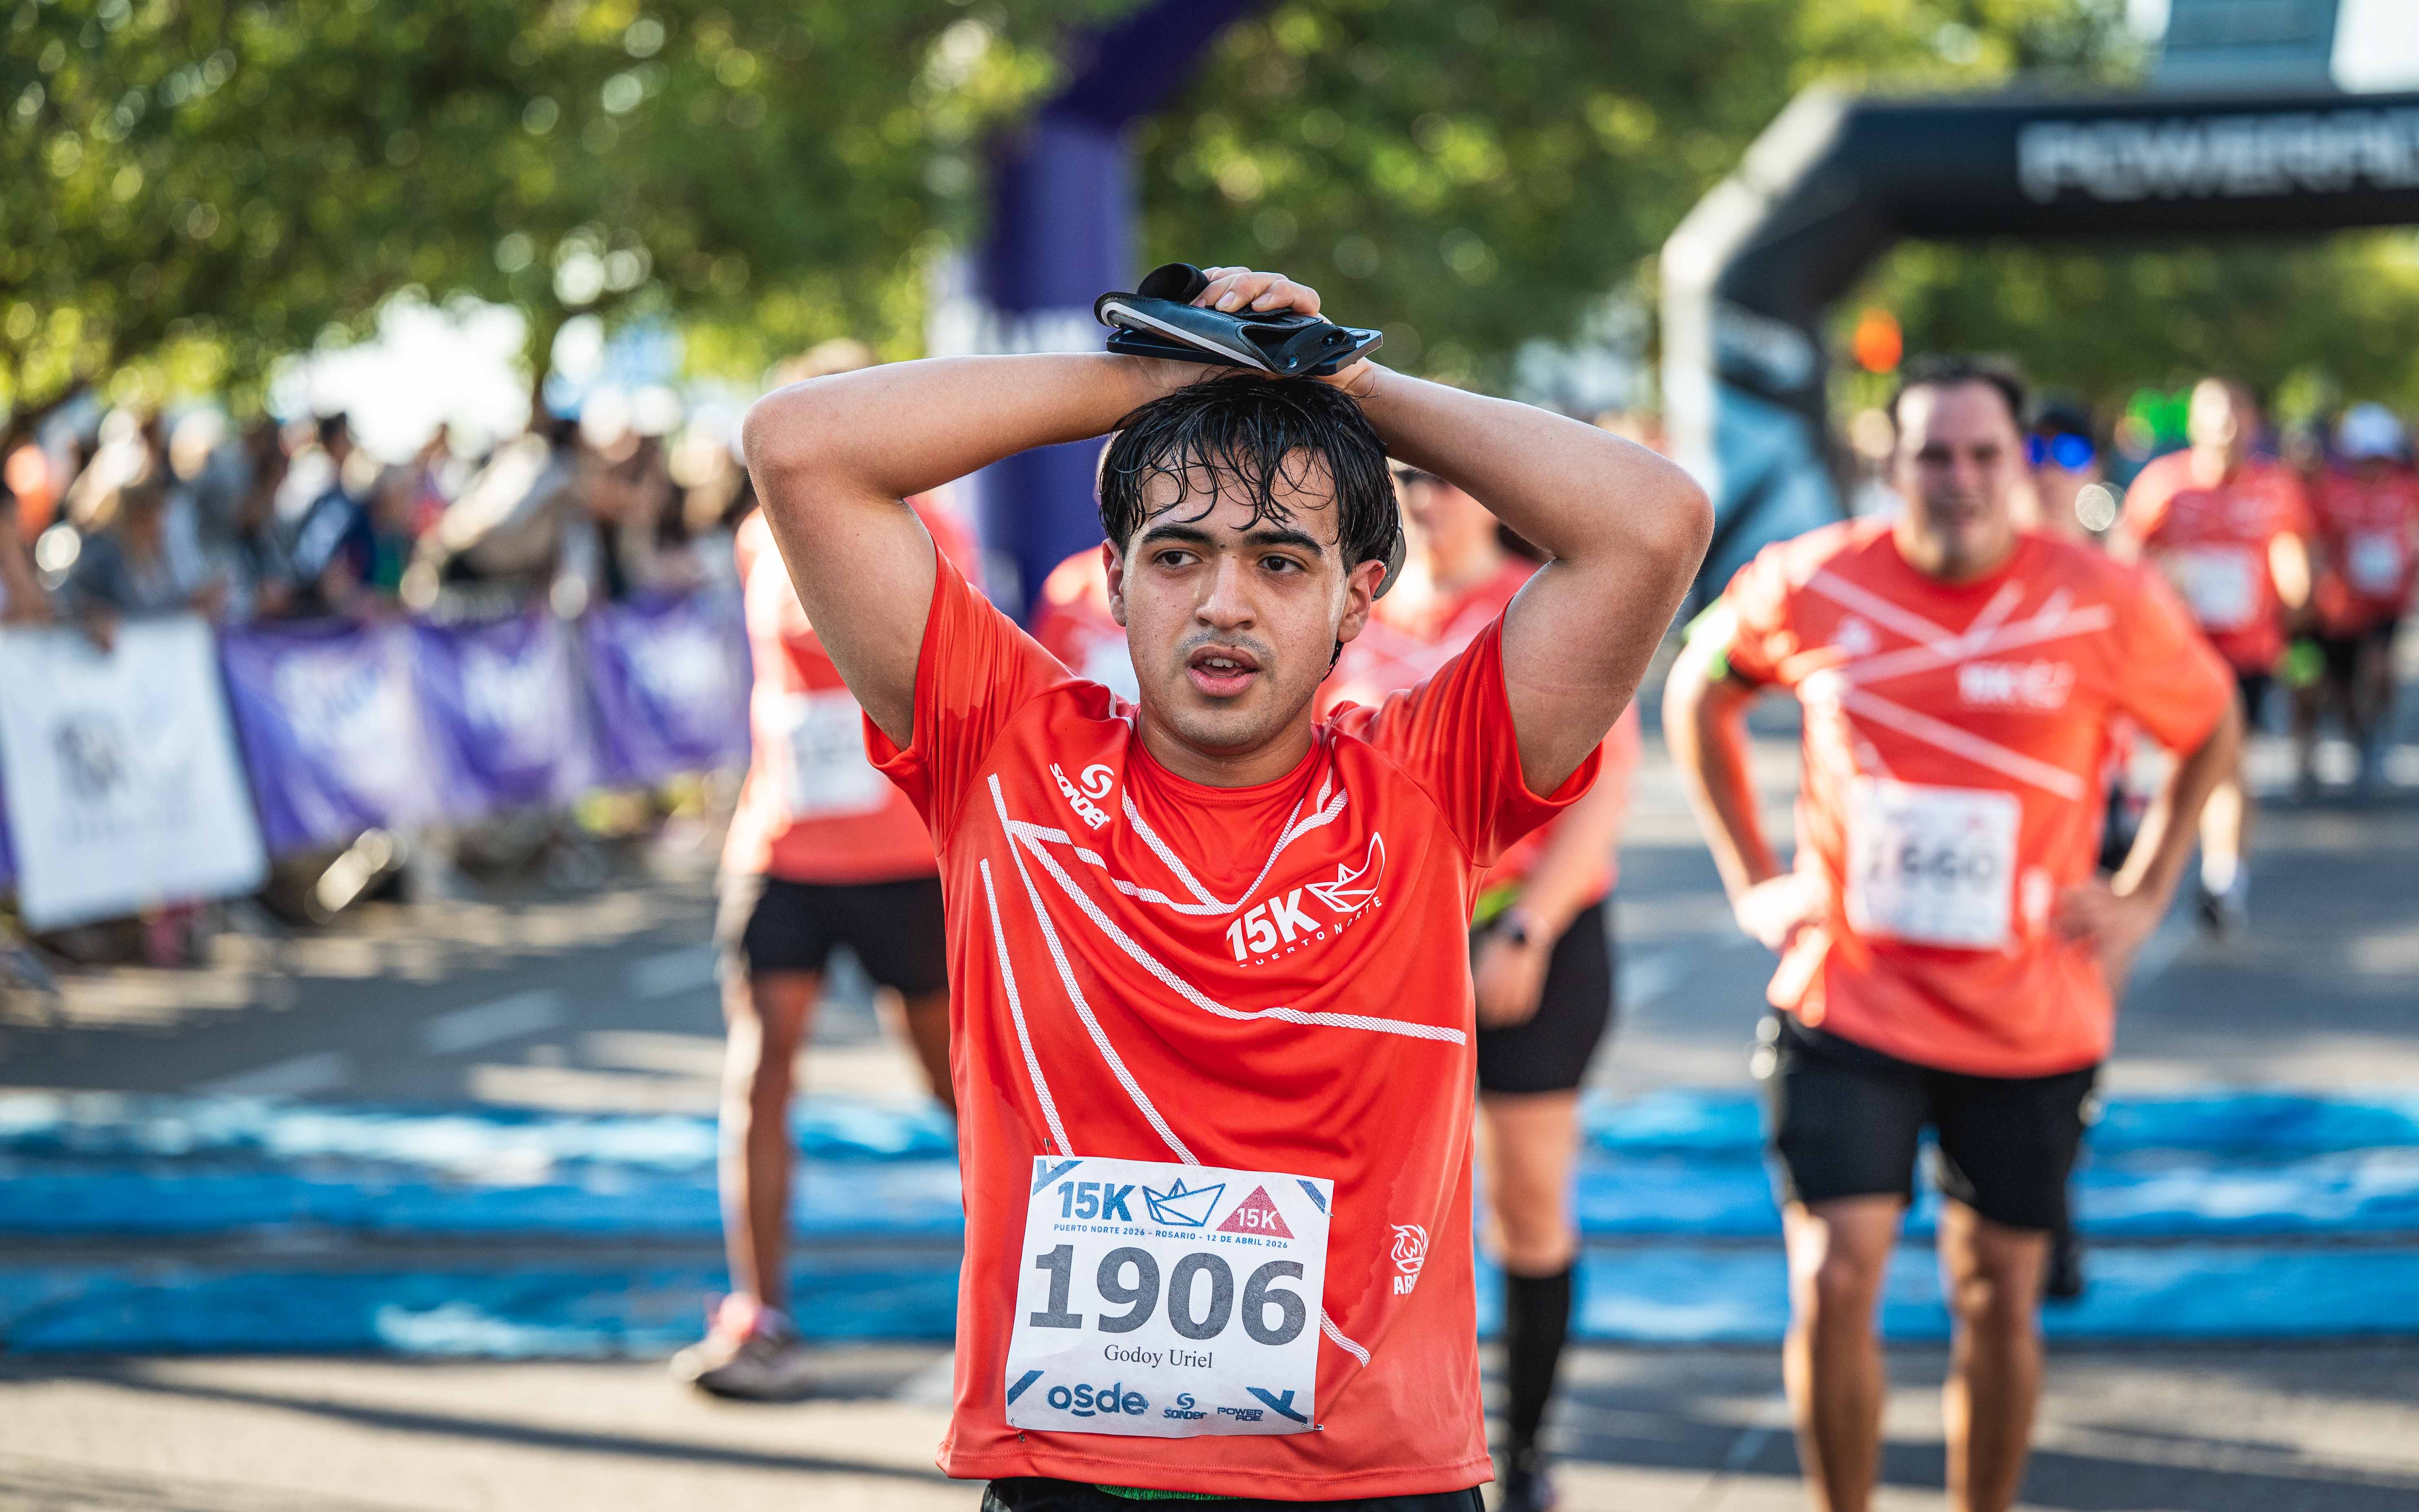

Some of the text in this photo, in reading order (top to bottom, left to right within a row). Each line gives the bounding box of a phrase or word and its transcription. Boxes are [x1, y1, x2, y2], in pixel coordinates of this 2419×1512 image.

[1226, 887, 1322, 962] 15K
[1334, 896, 1382, 935] NORTE
[1057, 1181, 1136, 1222] 15K
[1237, 1207, 1277, 1230] 15K
[1054, 1224, 1087, 1232] PUERTO
[1091, 1226, 1120, 1234] NORTE
[1123, 1228, 1145, 1236] 2026
[1155, 1230, 1195, 1240] ROSARIO
[1235, 1237, 1262, 1246] ABRIL
[1266, 1239, 1288, 1249] 2026
[1029, 1243, 1306, 1346] 1906
[1104, 1344, 1213, 1368] Godoy Uriel
[1048, 1382, 1146, 1416] osde
[1217, 1406, 1264, 1417] POWER
